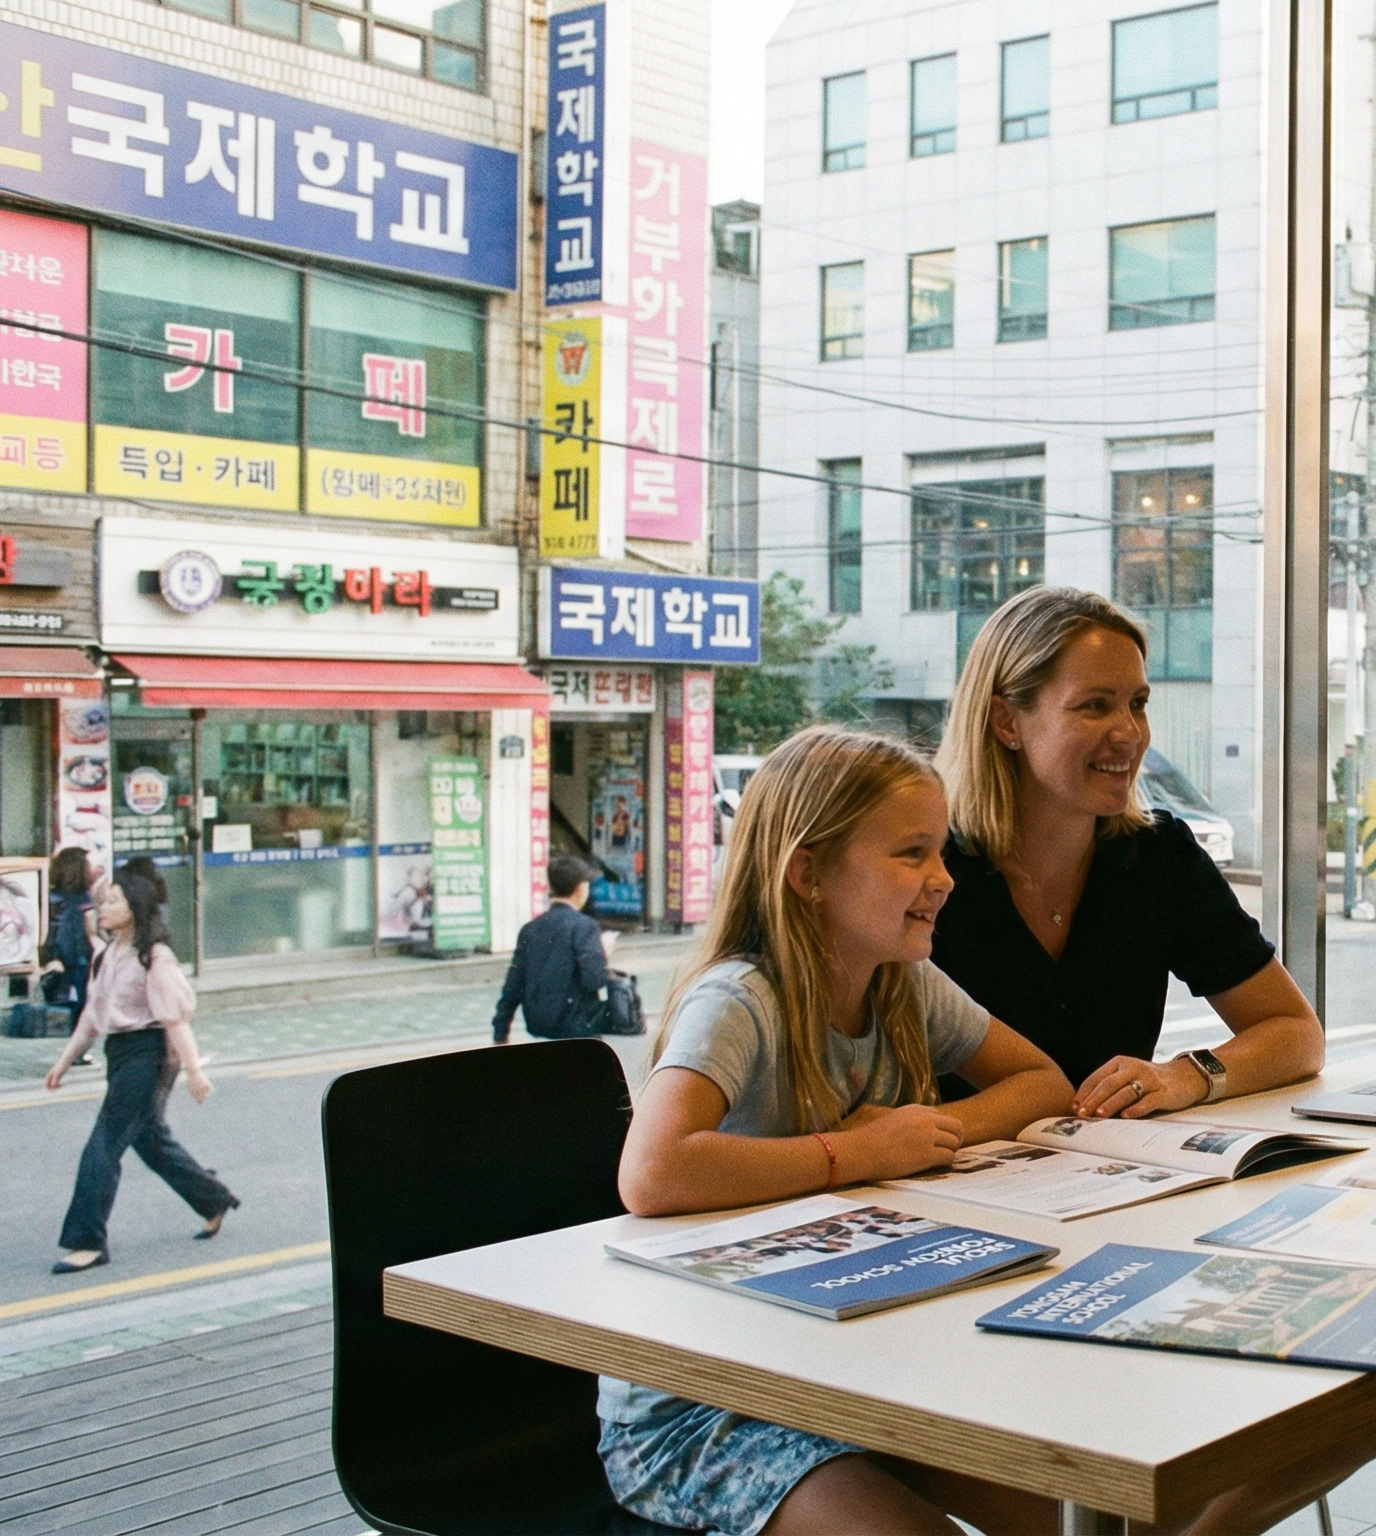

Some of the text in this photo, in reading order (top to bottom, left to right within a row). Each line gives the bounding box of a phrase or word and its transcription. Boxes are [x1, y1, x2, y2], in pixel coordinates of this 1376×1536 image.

[554, 18, 600, 273] 국제학교
[553, 399, 593, 522] 카페
[558, 582, 752, 651] 국제학교
[810, 1263, 904, 1289] SCHOOL
[934, 1241, 1016, 1266] SEOUL
[1061, 1293, 1127, 1324] SCHOOL
